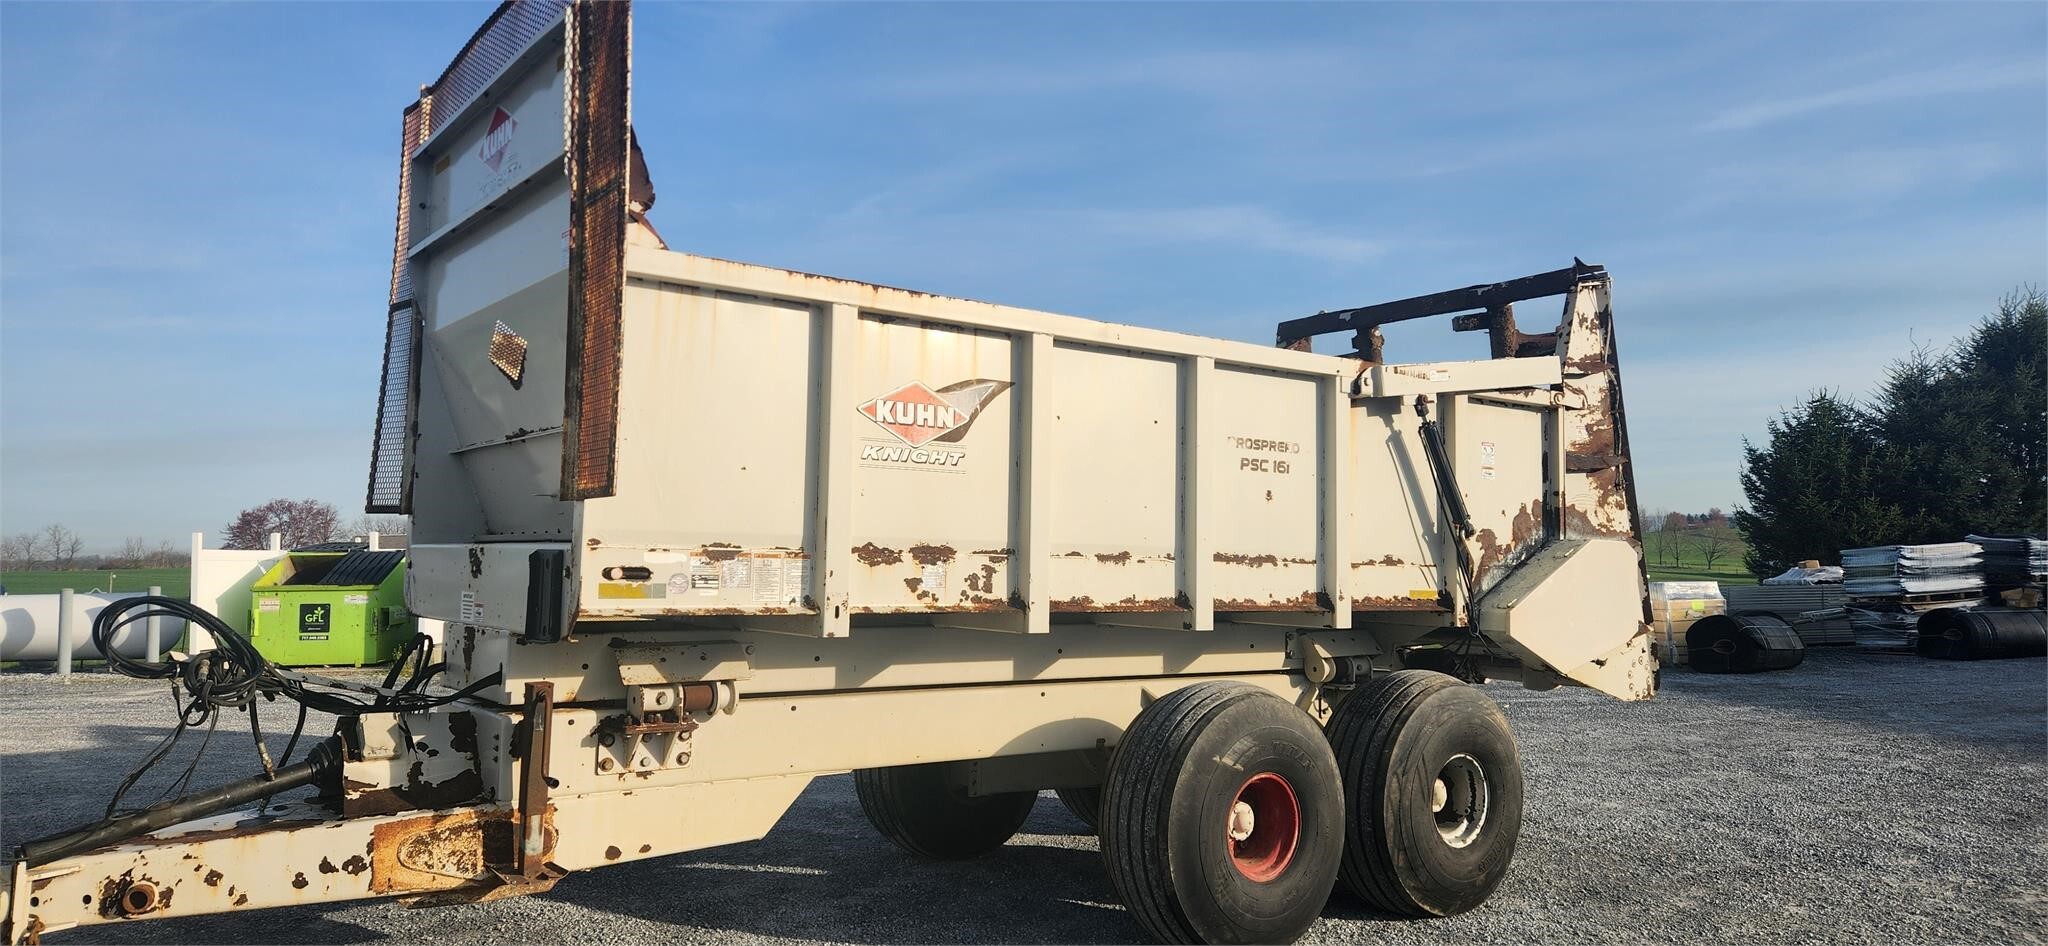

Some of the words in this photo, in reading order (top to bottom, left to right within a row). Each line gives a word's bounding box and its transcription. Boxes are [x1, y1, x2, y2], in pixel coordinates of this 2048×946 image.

[482, 117, 513, 160] KUHN
[875, 399, 956, 429] KUHN
[861, 445, 966, 467] KNIGHT
[1240, 457, 1269, 472] PSC
[305, 610, 324, 623] GFL
